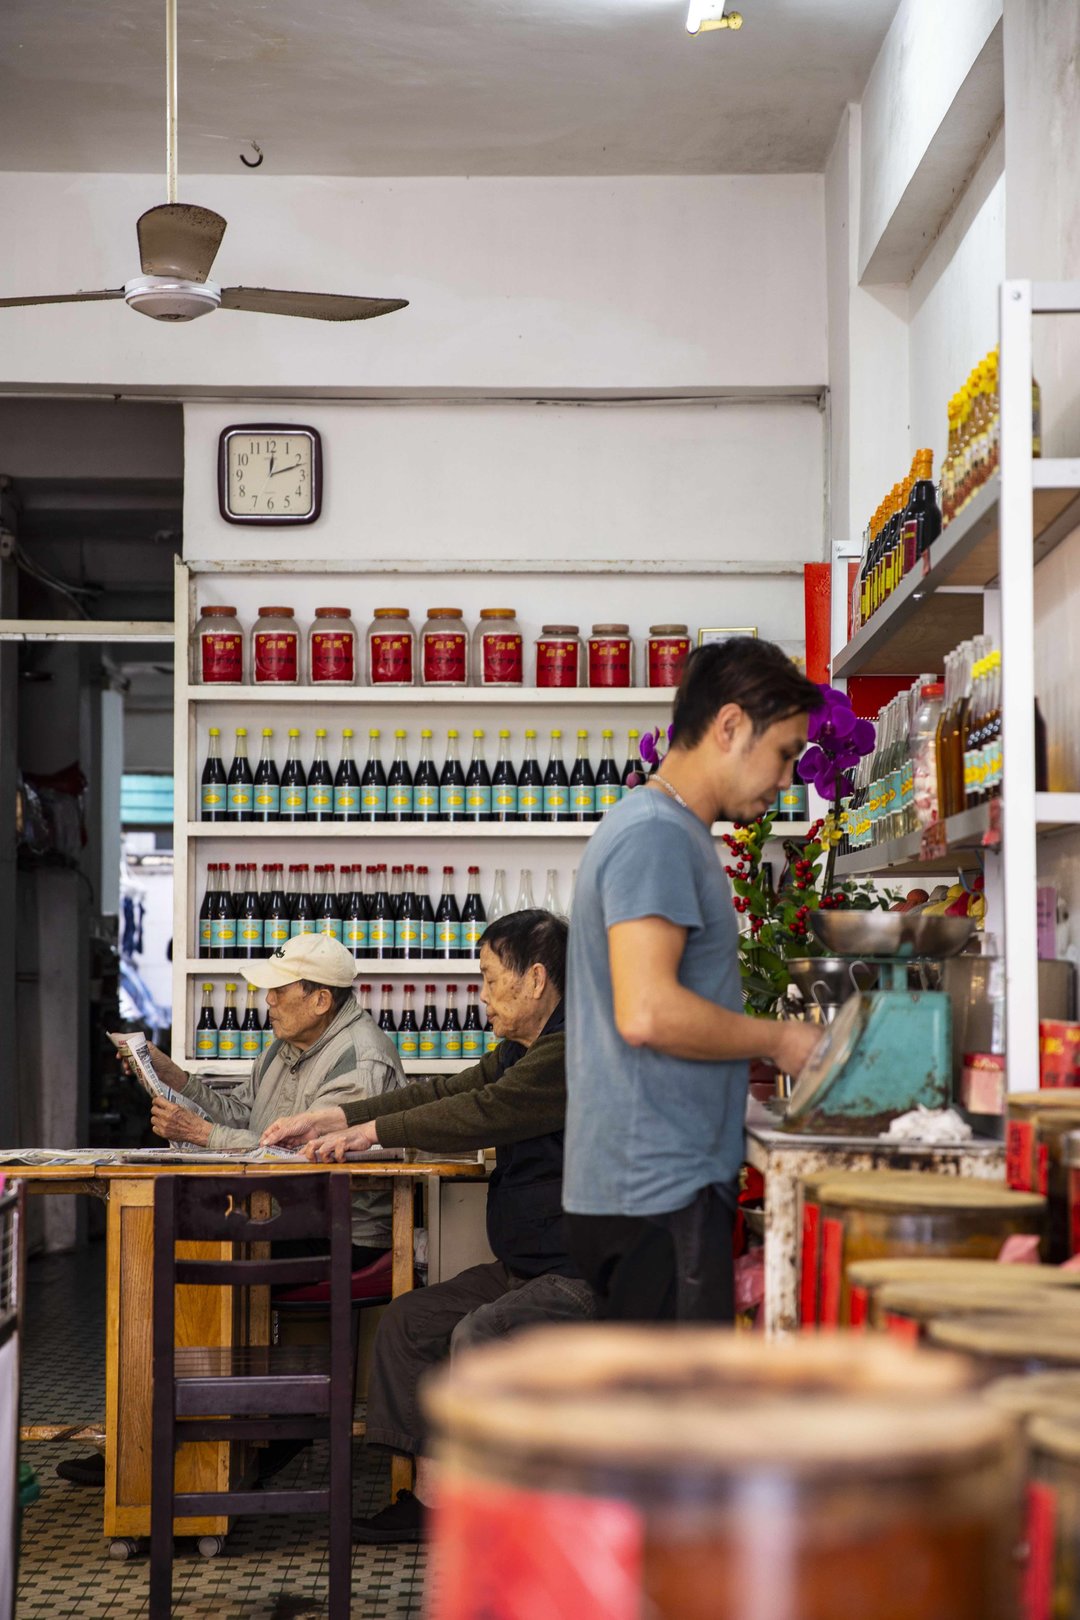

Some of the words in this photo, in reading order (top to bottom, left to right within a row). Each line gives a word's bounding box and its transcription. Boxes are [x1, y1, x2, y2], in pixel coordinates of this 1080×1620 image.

[250, 441, 260, 455] 11
[266, 440, 277, 453] 12
[237, 453, 249, 466] 10
[295, 453, 302, 466] 2
[236, 469, 243, 481] 9
[299, 469, 306, 482] 3
[239, 485, 246, 497] 8
[295, 485, 302, 497] 4
[251, 495, 258, 508] 7
[267, 497, 274, 510] 6
[283, 495, 290, 508] 5
